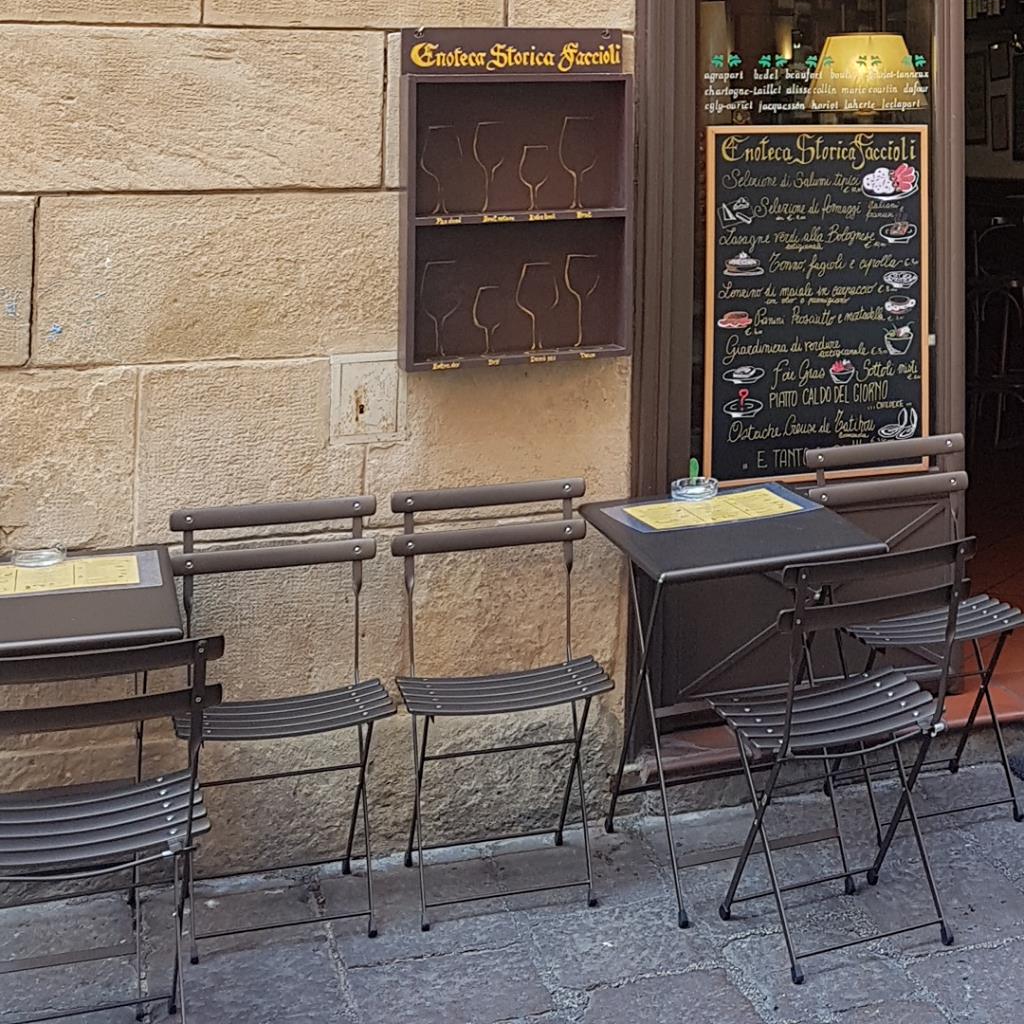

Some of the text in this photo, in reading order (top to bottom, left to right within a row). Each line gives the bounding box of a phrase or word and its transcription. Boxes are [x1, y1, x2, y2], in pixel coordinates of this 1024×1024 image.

[410, 41, 622, 72] Enoteca Storica Faccioli
[813, 83, 837, 94] collin
[721, 133, 917, 170] Enoteca Storica Faccioli
[721, 168, 777, 189] Selezione
[753, 196, 806, 218] Selezione
[808, 197, 820, 214] di
[822, 193, 862, 220] formaggi
[719, 227, 771, 253] Lasagne
[800, 226, 824, 243] alla
[824, 223, 876, 246] Bolognese
[806, 253, 847, 279] fagioli
[848, 258, 856, 269] e
[764, 283, 776, 297] di
[779, 283, 814, 297] maiale
[816, 286, 830, 296] in
[753, 307, 785, 327] Panini
[837, 313, 843, 324] e
[790, 336, 802, 353] di
[798, 358, 826, 387] Gras
[769, 379, 889, 409] PIATTO CALDO DEL GIORNO
[757, 449, 768, 469] E
